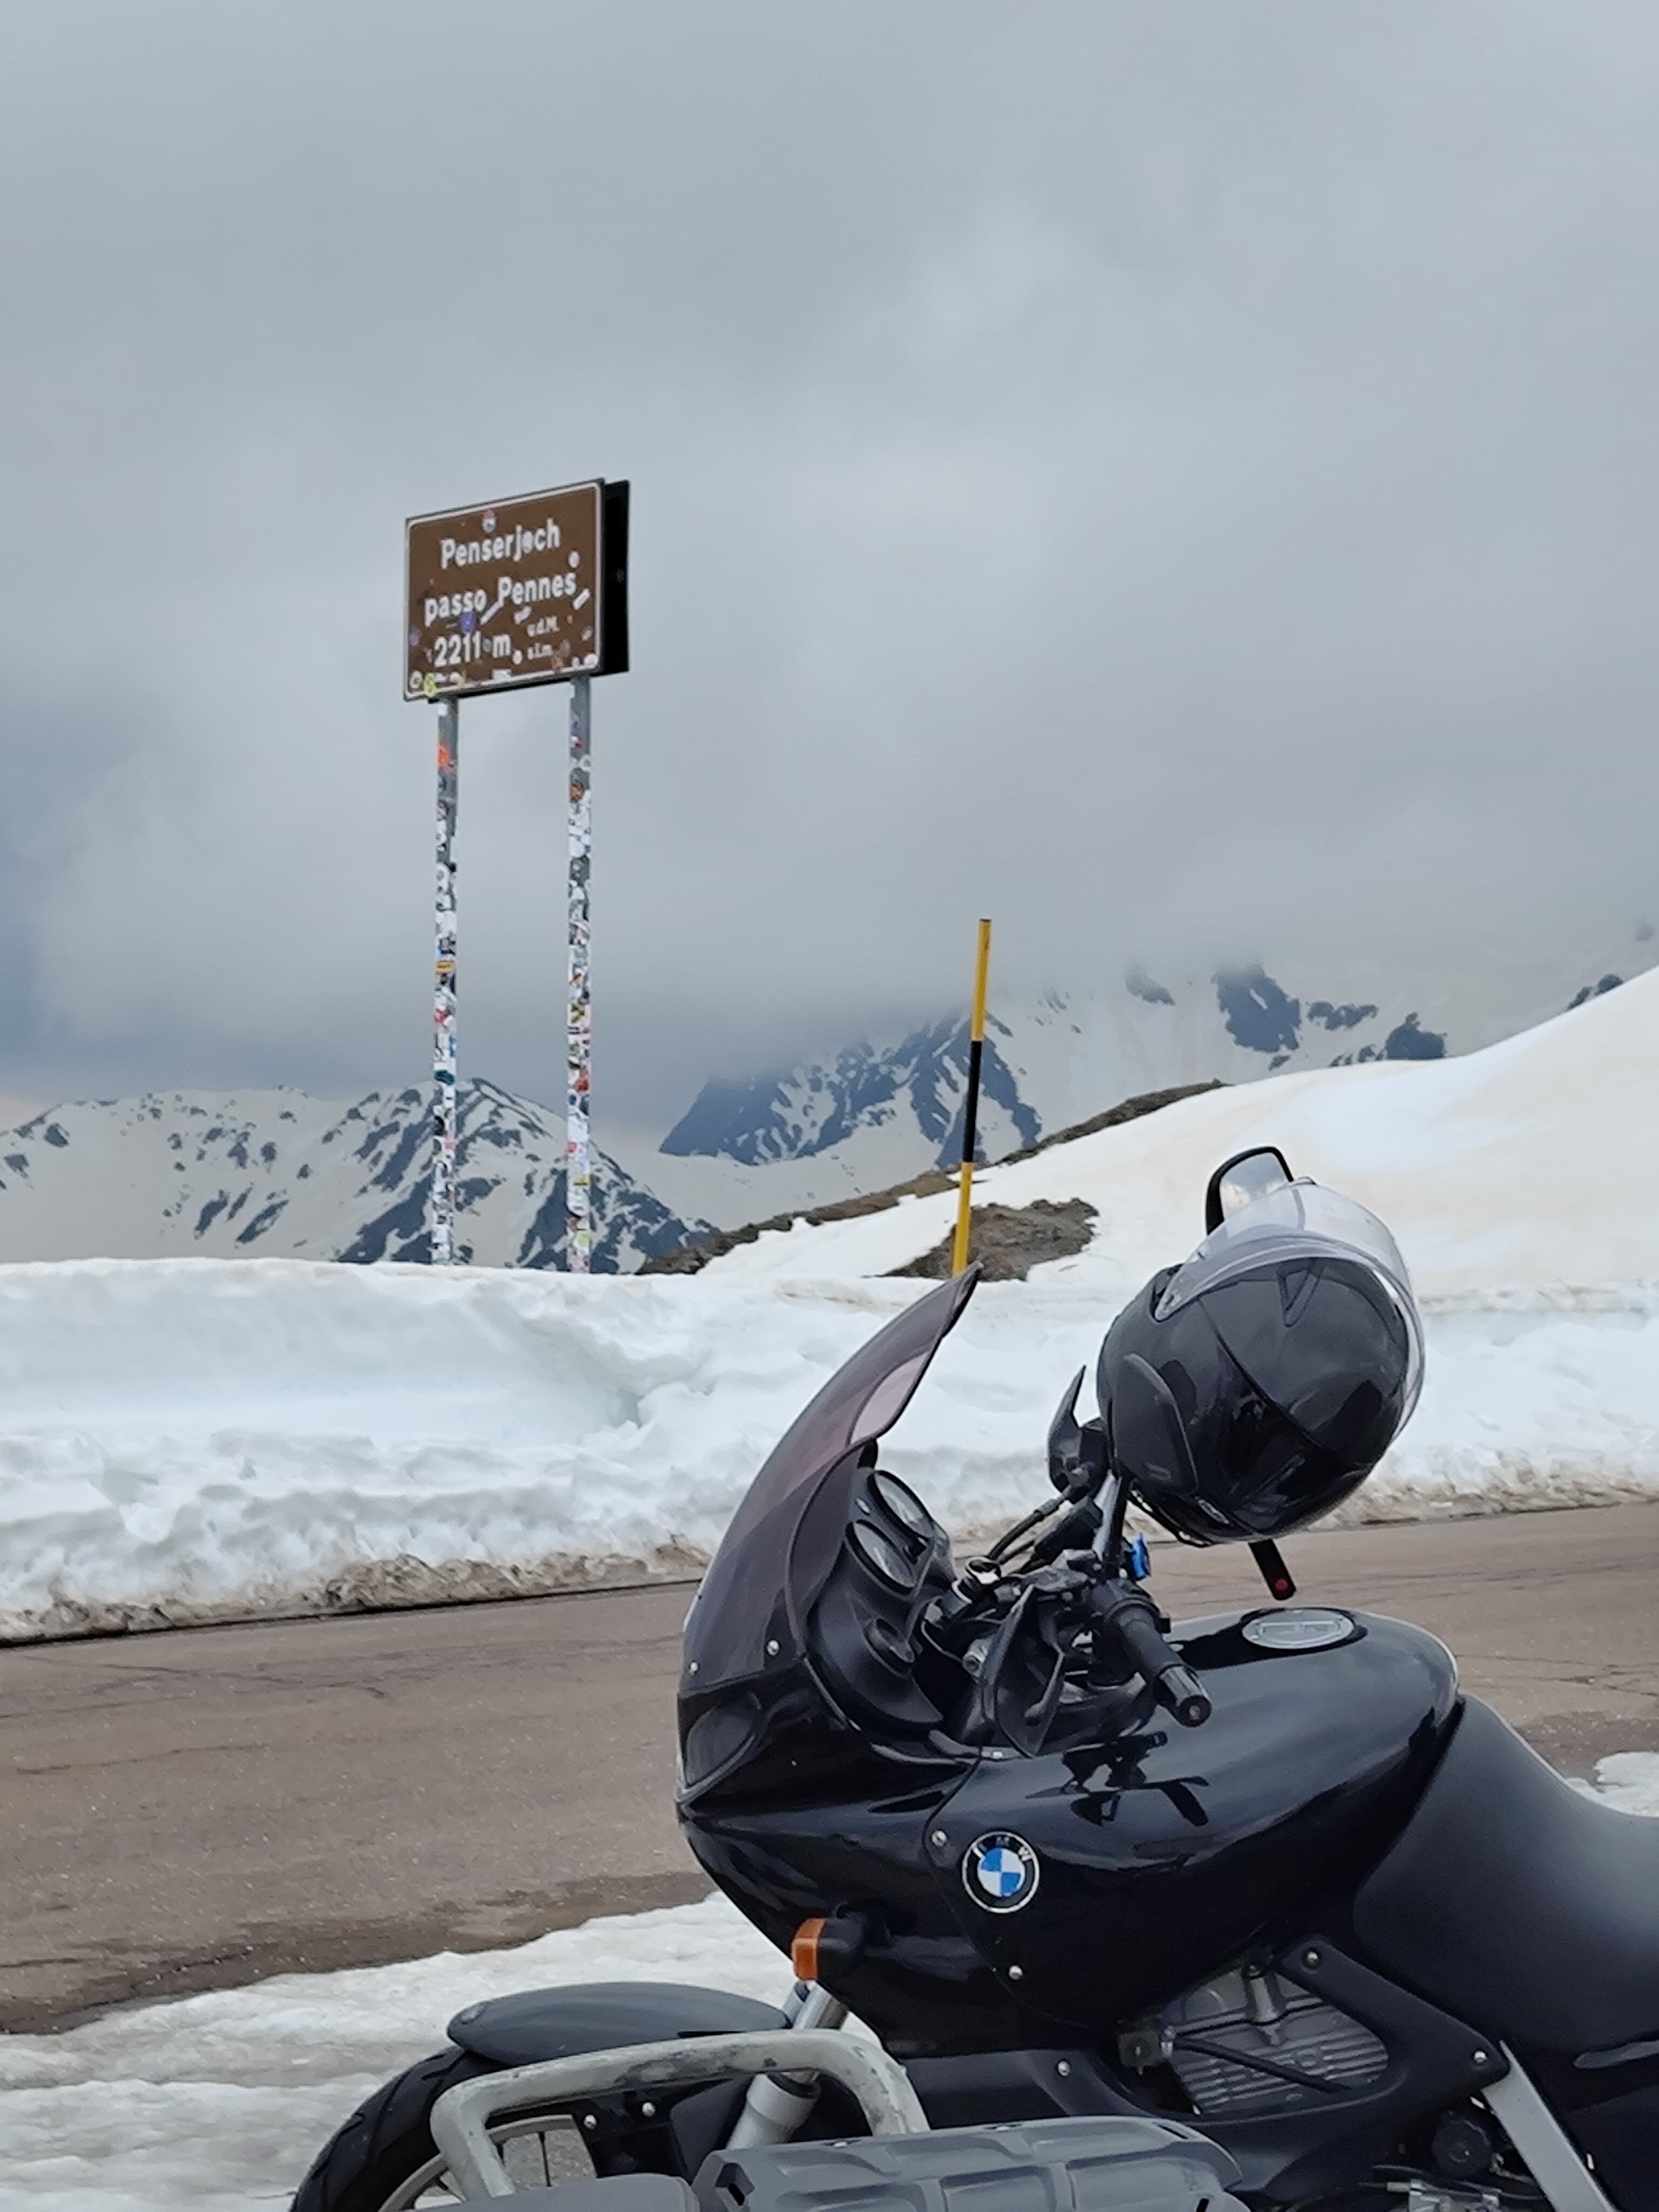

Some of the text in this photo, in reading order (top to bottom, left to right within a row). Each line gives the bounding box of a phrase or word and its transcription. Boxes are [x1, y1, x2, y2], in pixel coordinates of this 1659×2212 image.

[440, 518, 560, 569] Penserjoch
[425, 590, 487, 627] passo
[497, 572, 577, 607] Pennes
[434, 632, 512, 667] 2211 m
[972, 1836, 1033, 1862] BMW
